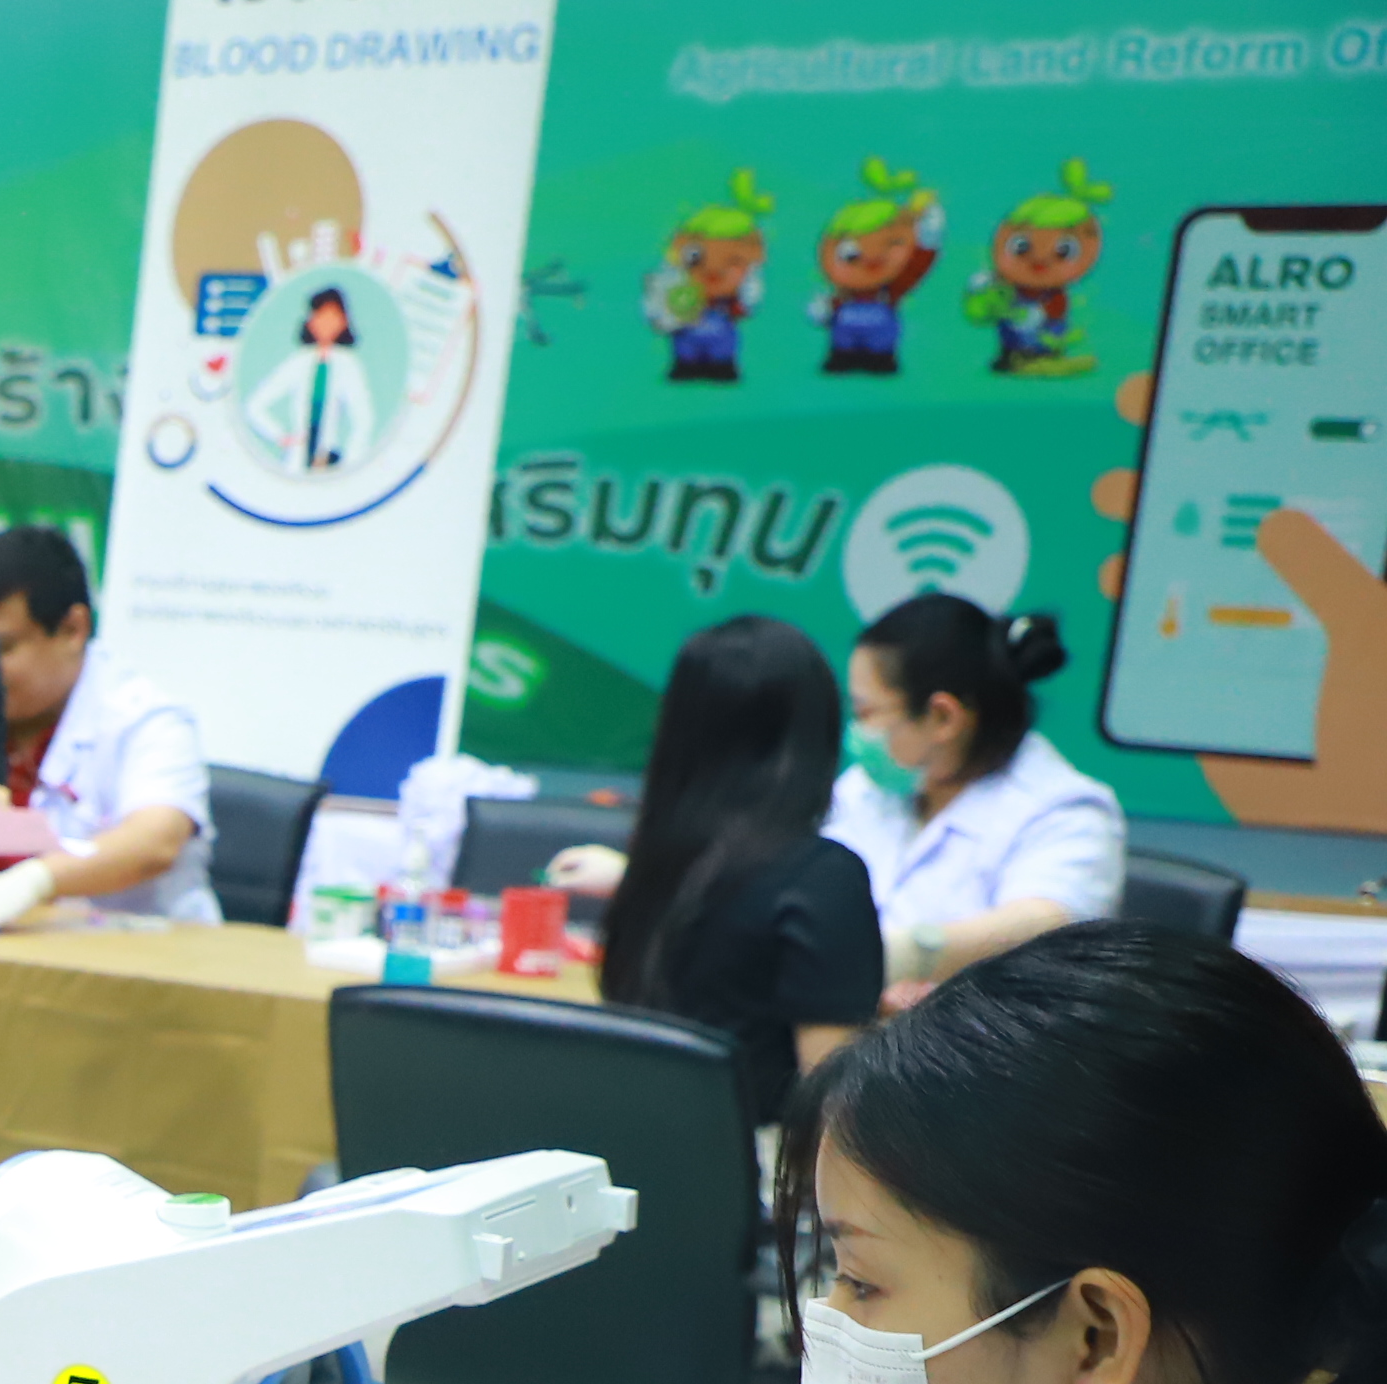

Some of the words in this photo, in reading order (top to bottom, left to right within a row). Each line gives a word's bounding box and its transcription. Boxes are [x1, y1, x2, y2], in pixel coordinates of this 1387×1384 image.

[173, 33, 318, 79] BLOOD
[327, 21, 542, 71] DRAWING
[967, 39, 1089, 84] Land
[1112, 31, 1304, 79] Reform
[1206, 252, 1357, 291] ALRO
[1200, 301, 1321, 330] SMART
[1193, 336, 1320, 366] OFFICE
